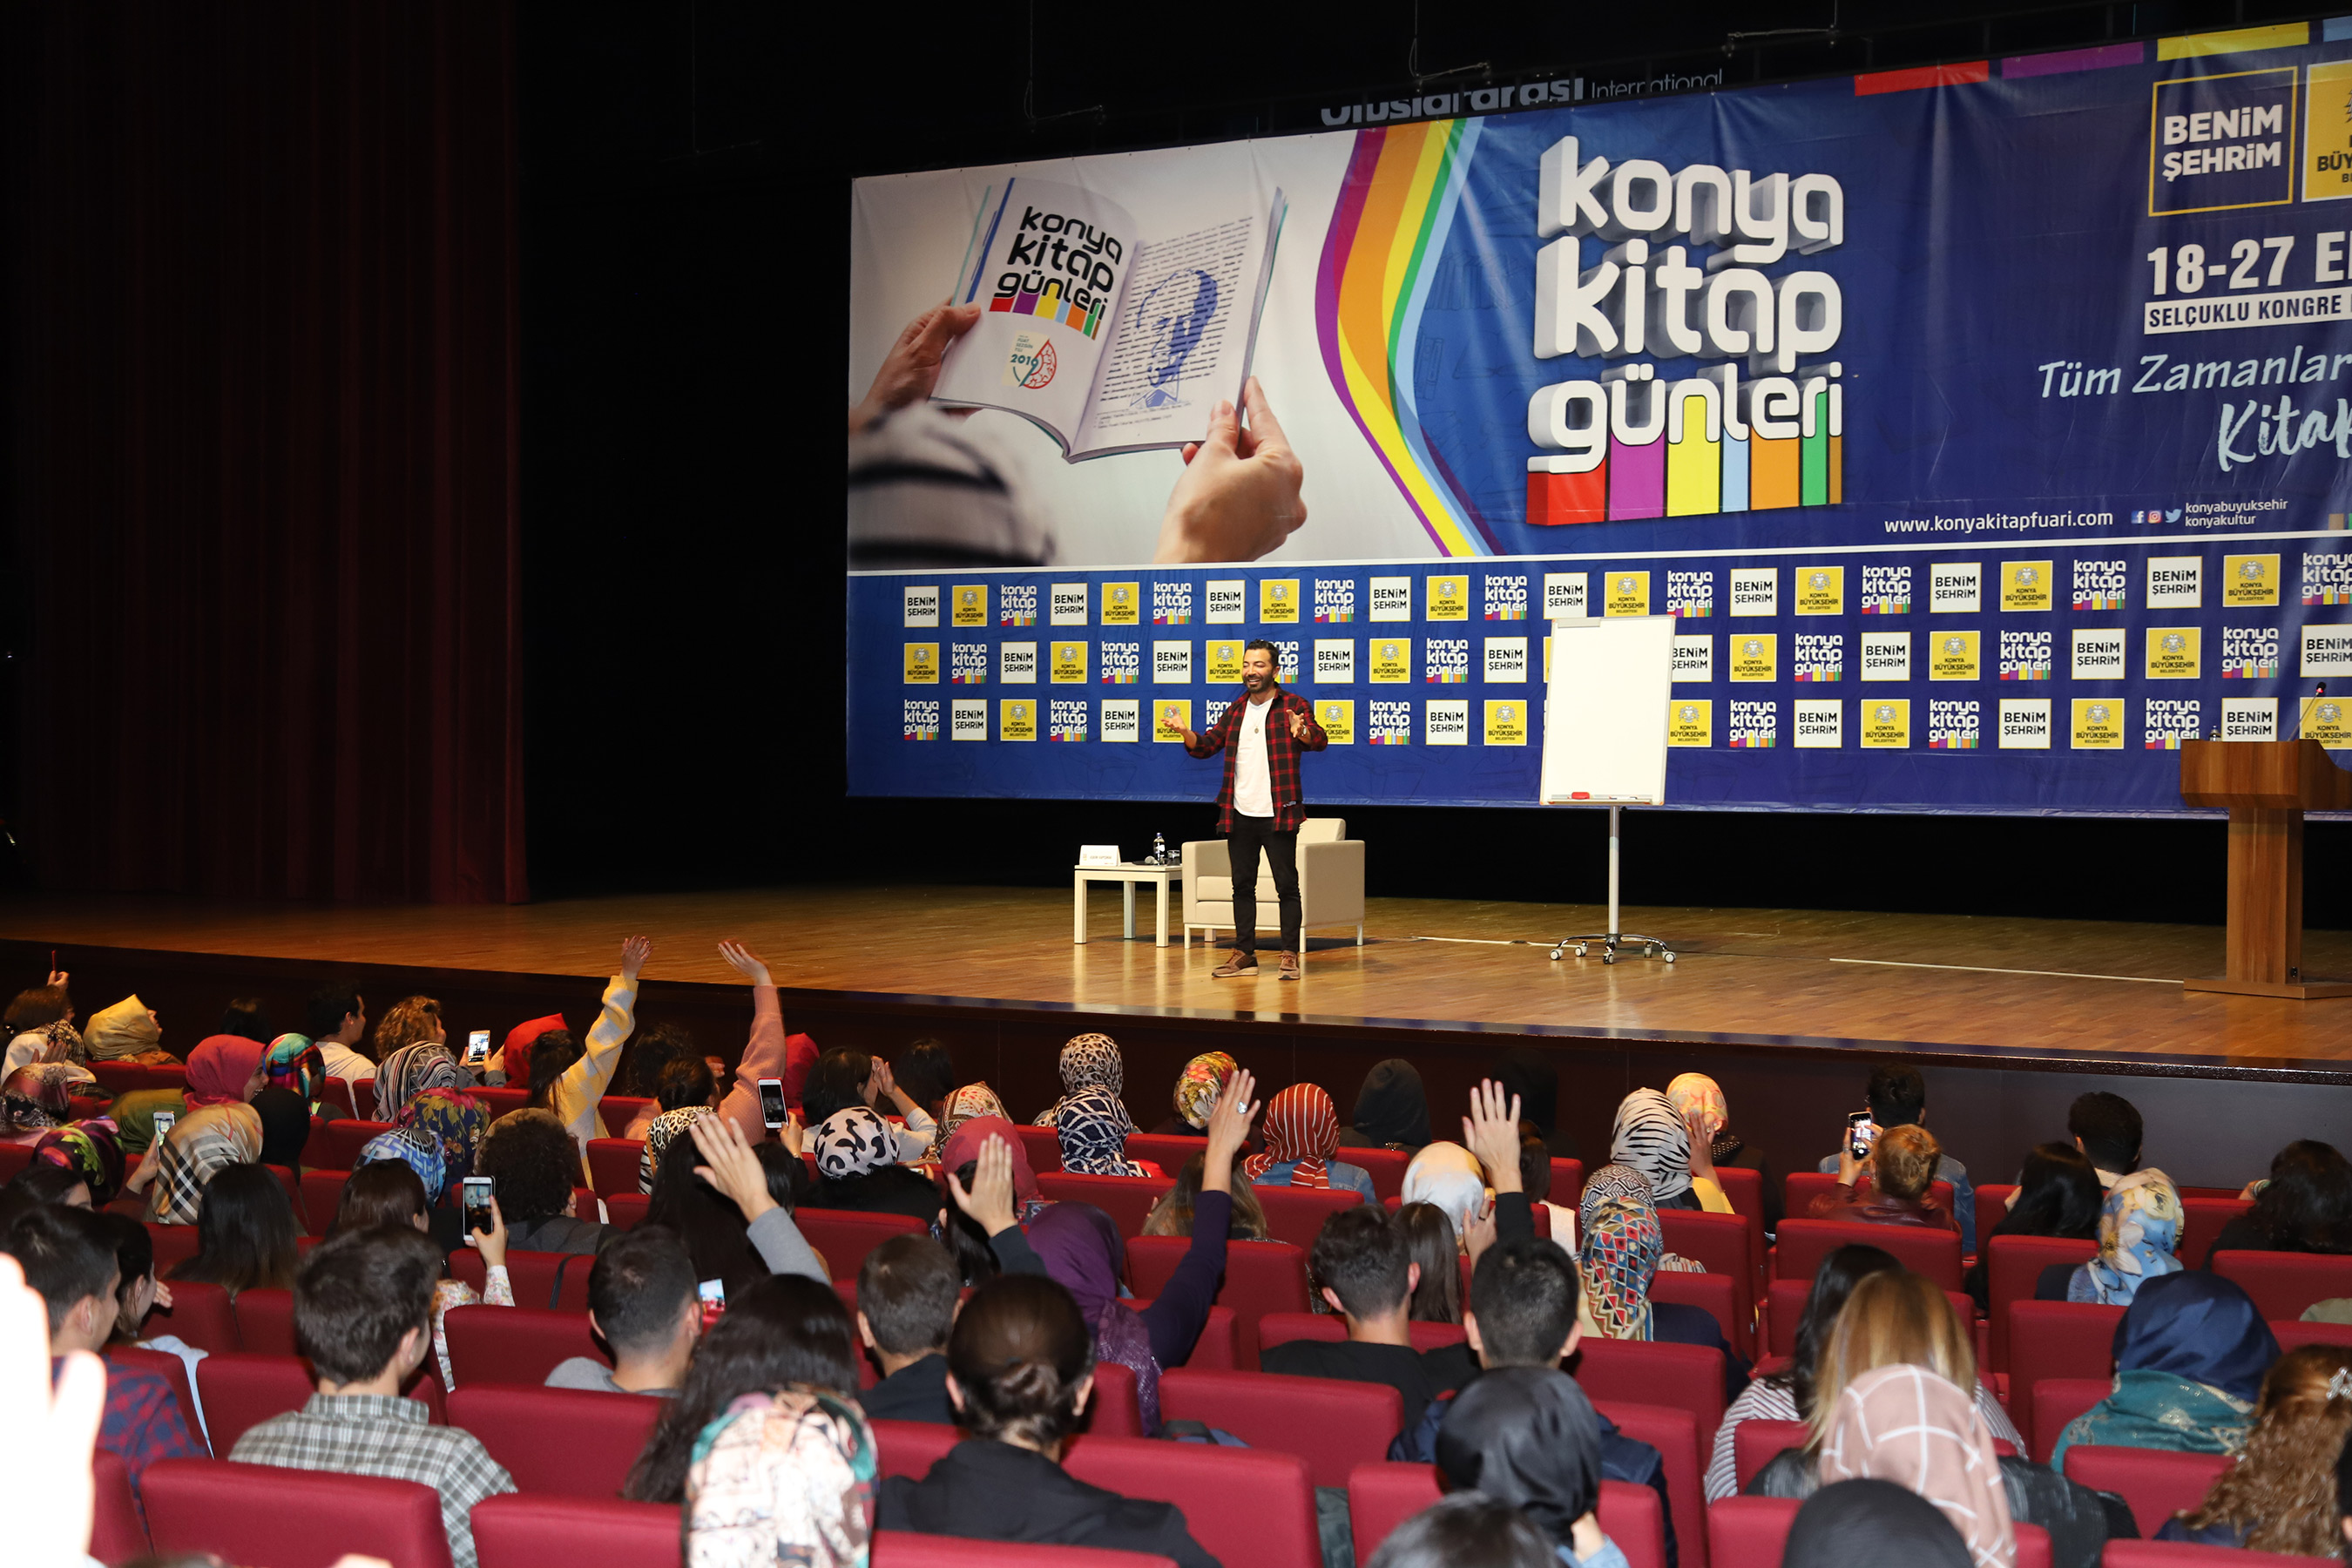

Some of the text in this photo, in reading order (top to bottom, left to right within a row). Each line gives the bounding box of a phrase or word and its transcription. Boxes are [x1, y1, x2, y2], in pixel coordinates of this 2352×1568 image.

[1537, 136, 1844, 268] konya
[1020, 206, 1123, 266] konya
[1006, 233, 1115, 293] kitap
[2146, 230, 2352, 296] 18-27 E
[993, 269, 1108, 321] günleri
[1534, 235, 1842, 375] kitap
[2149, 294, 2342, 328] SELÇUKLU KONGRE
[2038, 345, 2352, 398] Tüm Zamanlar
[1527, 362, 1842, 474] günleri
[2185, 499, 2288, 515] konyabuyuksehir
[1884, 510, 2113, 535] www.konyakitapfuari.com
[2185, 513, 2256, 529] konyakultur
[2073, 559, 2126, 574] konya
[2302, 552, 2352, 568] kony
[1667, 570, 1713, 584] konya
[1862, 565, 1911, 579] konya
[1154, 582, 1192, 594] konya
[1315, 578, 1354, 591] konya
[1485, 575, 1527, 588] konya
[1862, 578, 1911, 595] kitap
[2073, 573, 2126, 591] kitap
[1002, 585, 1037, 597] konya
[1315, 591, 1354, 605] kitap
[1485, 587, 1527, 603] kitap
[1667, 583, 1713, 599] kitap
[2072, 590, 2126, 604] günleri
[1002, 596, 1037, 610] kitap
[1154, 593, 1192, 608] kitap
[1485, 601, 1526, 614] günleri
[1667, 598, 1712, 612] günleri
[1862, 594, 1910, 608] günleri
[1001, 609, 1036, 621] günleri
[1153, 607, 1191, 619] günleri
[1315, 605, 1354, 618] günleri
[1795, 633, 1842, 647] konya
[2000, 630, 2051, 645] konya
[2223, 626, 2278, 641] konya
[952, 642, 987, 654] konya
[1102, 641, 1139, 653] konya
[1427, 638, 1468, 651] konya
[2223, 640, 2278, 658] kitap
[1427, 650, 1468, 666] kitap
[1795, 646, 1842, 663] kitap
[2000, 644, 2051, 660] kitap
[953, 653, 987, 667] kitap
[1103, 652, 1139, 667] kitap
[2000, 659, 2051, 674] günleri
[2222, 657, 2277, 672] günleri
[952, 666, 986, 679] günleri
[1102, 666, 1139, 679] günleri
[1426, 665, 1468, 678] günleri
[1794, 662, 1842, 675] günleri
[904, 699, 938, 711] konya
[1051, 699, 1087, 711] konya
[1369, 700, 1410, 713] konya
[1730, 700, 1776, 713] konya
[1930, 699, 1979, 713] konya
[2146, 698, 2200, 713] konya
[904, 710, 938, 724] kitap
[1051, 711, 1087, 725] kitap
[1370, 712, 1410, 727] kitap
[1730, 713, 1776, 728] kitap
[1930, 713, 1979, 729] kitap
[2146, 712, 2200, 729] kitap
[904, 723, 938, 735] günleri
[1051, 724, 1086, 736] günleri
[1369, 727, 1409, 740] günleri
[1730, 727, 1775, 741] günleri
[1930, 728, 1978, 742] günleri
[2146, 728, 2199, 740] günleri
